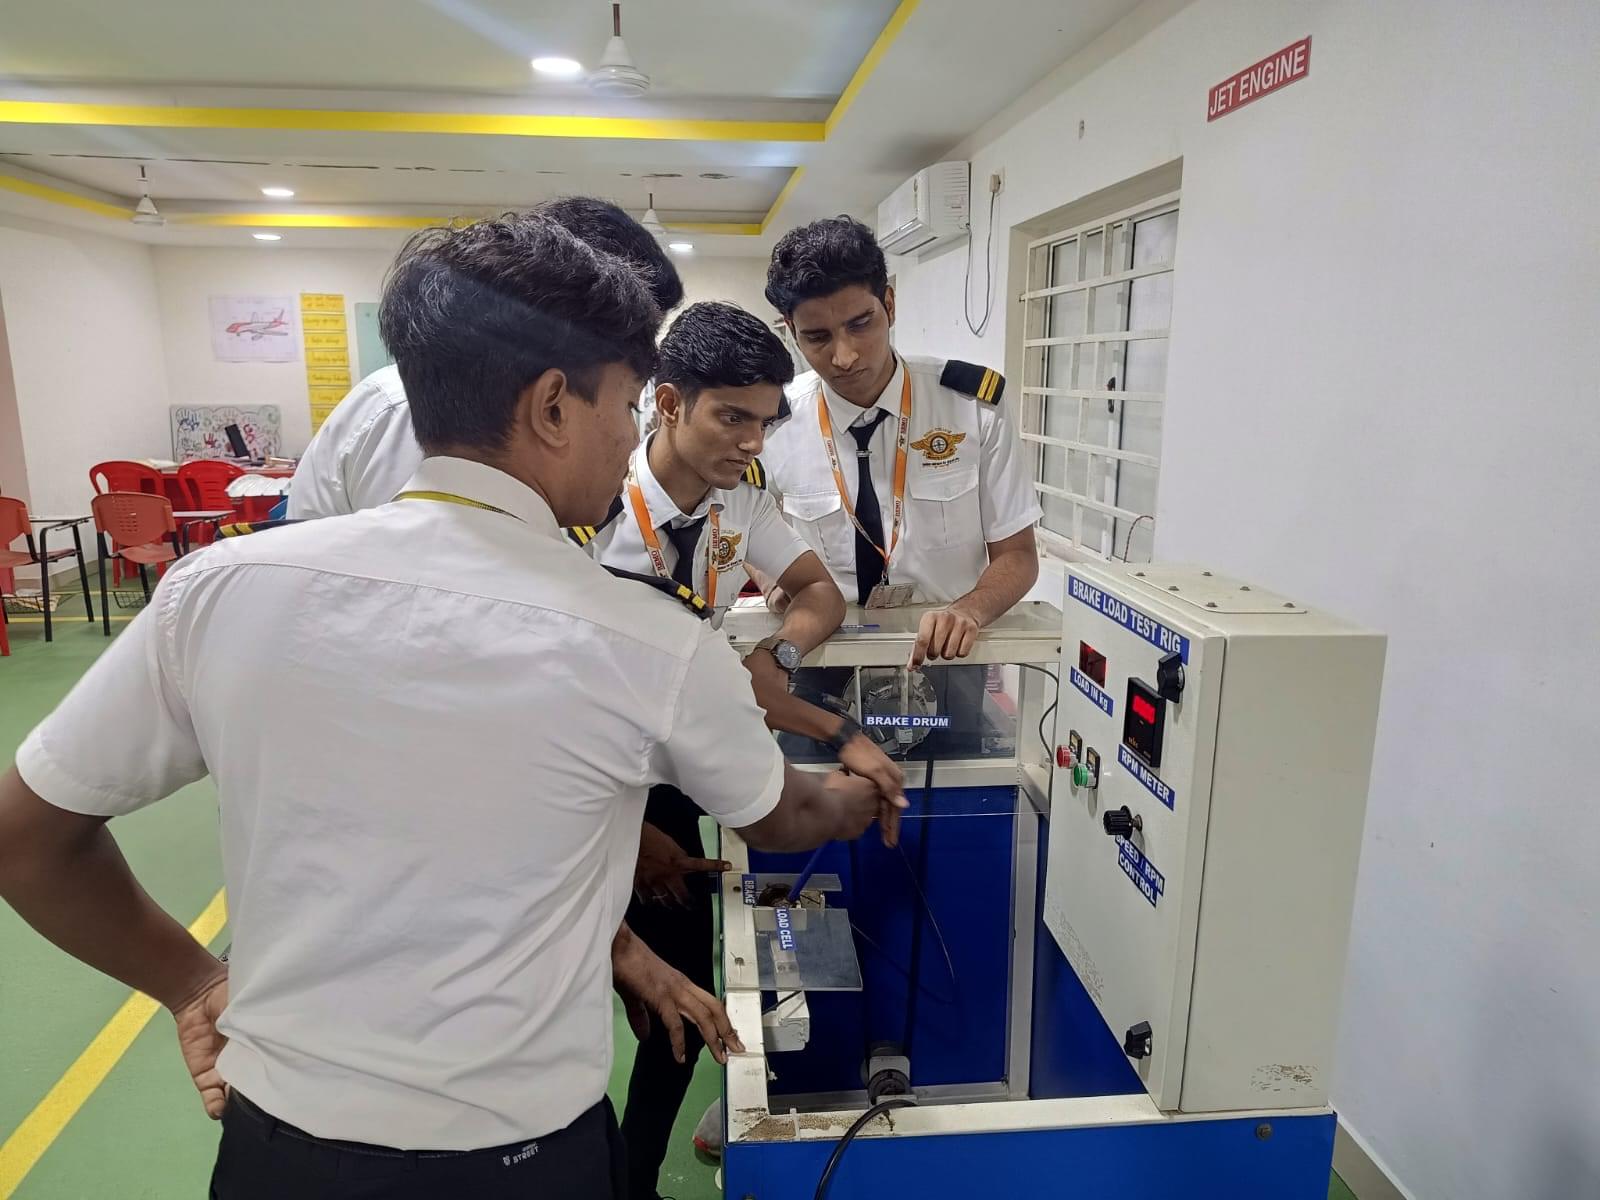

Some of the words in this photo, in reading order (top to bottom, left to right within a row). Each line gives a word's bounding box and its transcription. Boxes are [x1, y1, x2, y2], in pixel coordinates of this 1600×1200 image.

[1209, 80, 1236, 116] JET
[1239, 44, 1306, 101] ENGINE
[1073, 578, 1101, 609] BRAKE
[1102, 594, 1128, 624] LOAD
[1130, 610, 1158, 641] TEST
[1160, 627, 1181, 654] RIG
[1074, 671, 1090, 693] LOAD
[1091, 684, 1098, 701] IN
[1099, 692, 1109, 711] kg
[866, 716, 909, 726] BRAKE
[912, 717, 949, 727] DRUM
[1121, 749, 1138, 774] RPM
[1139, 764, 1170, 802] METER
[744, 880, 755, 905] BRAKE
[1119, 853, 1157, 905] CONTROL
[1144, 862, 1164, 892] RPM
[776, 908, 789, 929] LOAD
[780, 930, 793, 949] CELL
